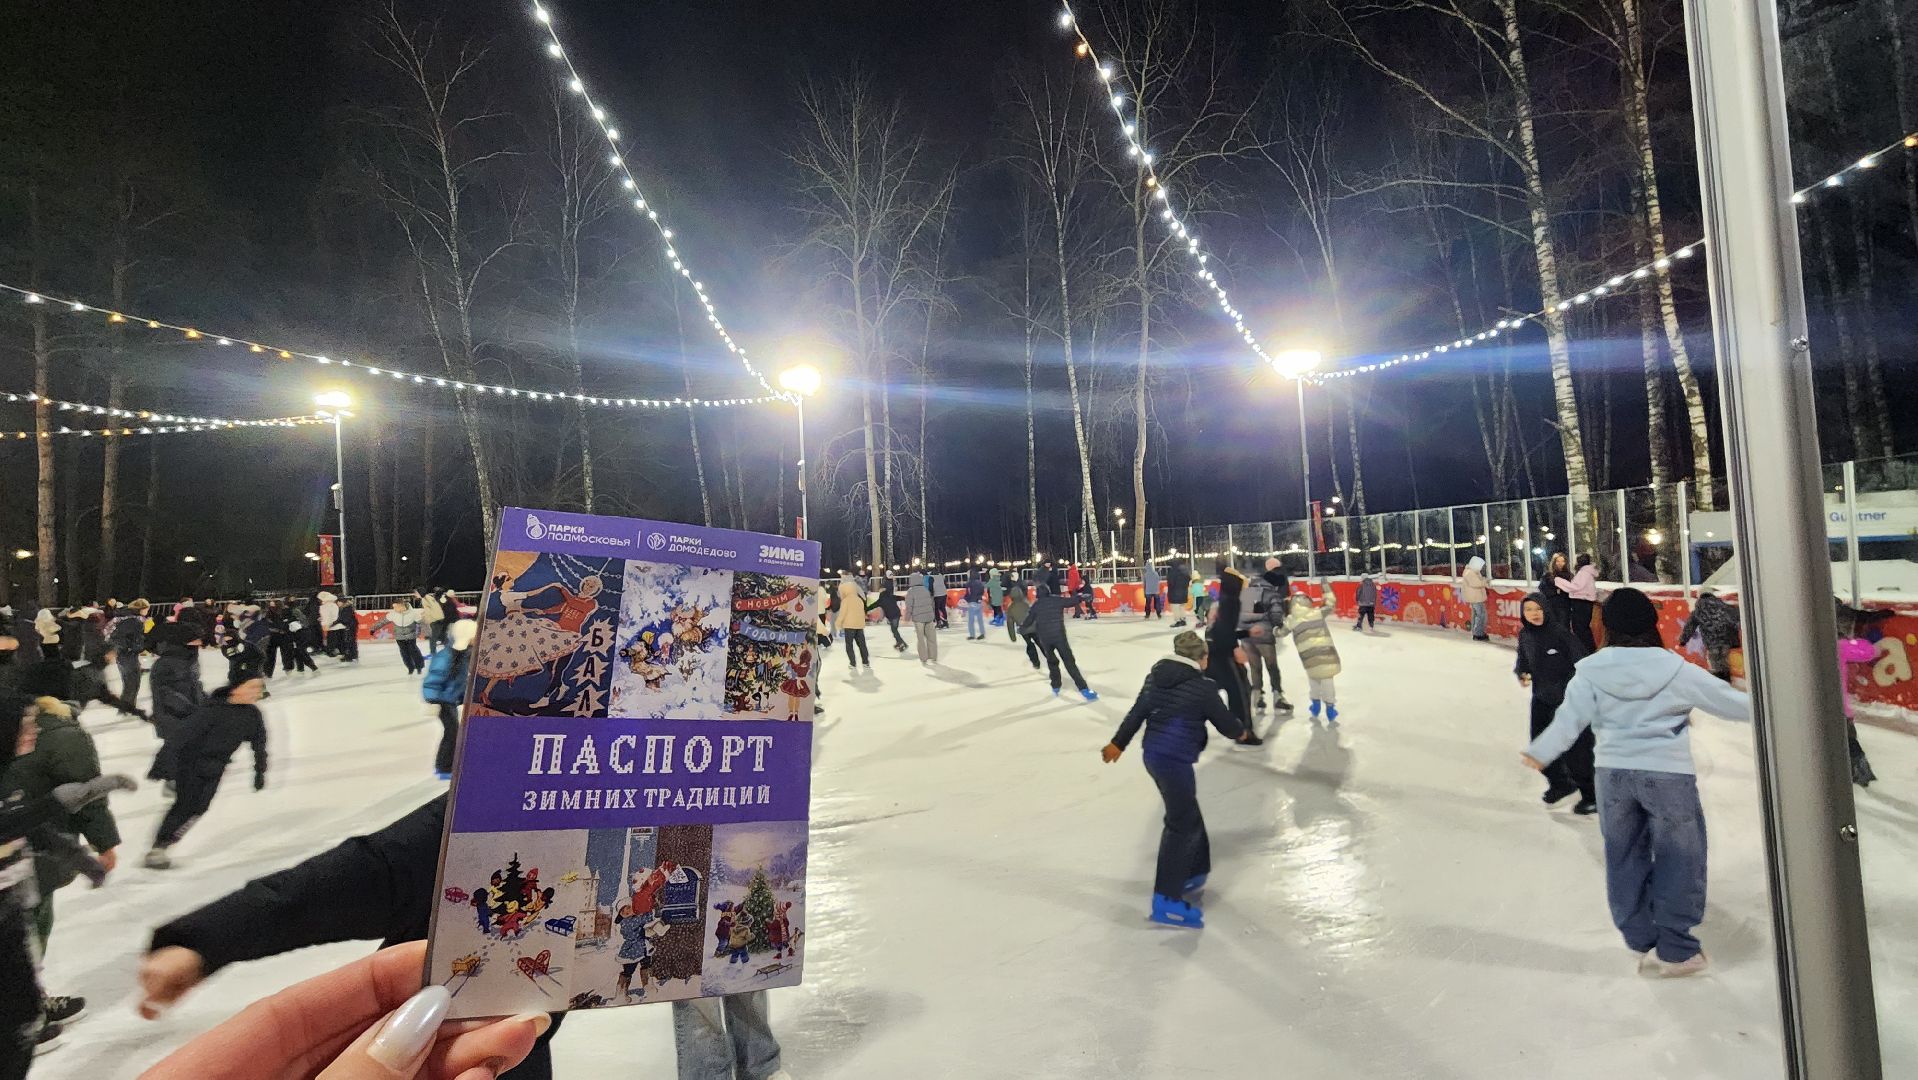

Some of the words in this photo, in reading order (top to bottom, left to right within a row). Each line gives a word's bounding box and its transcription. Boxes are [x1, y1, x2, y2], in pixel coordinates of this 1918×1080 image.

[548, 523, 585, 534] ПАРКИ
[547, 532, 631, 547] ПОДМОСКОВЬЯ
[669, 535, 702, 545] ПАРКИ
[668, 543, 737, 558] ДОМОДЕДОВО
[735, 600, 742, 609] С
[747, 593, 788, 608] НОВЫМ
[528, 734, 773, 775] ПАСПОРТ
[522, 788, 638, 811] ЗИМНИХ
[643, 783, 771, 811] ТРАДИЦИЙ
